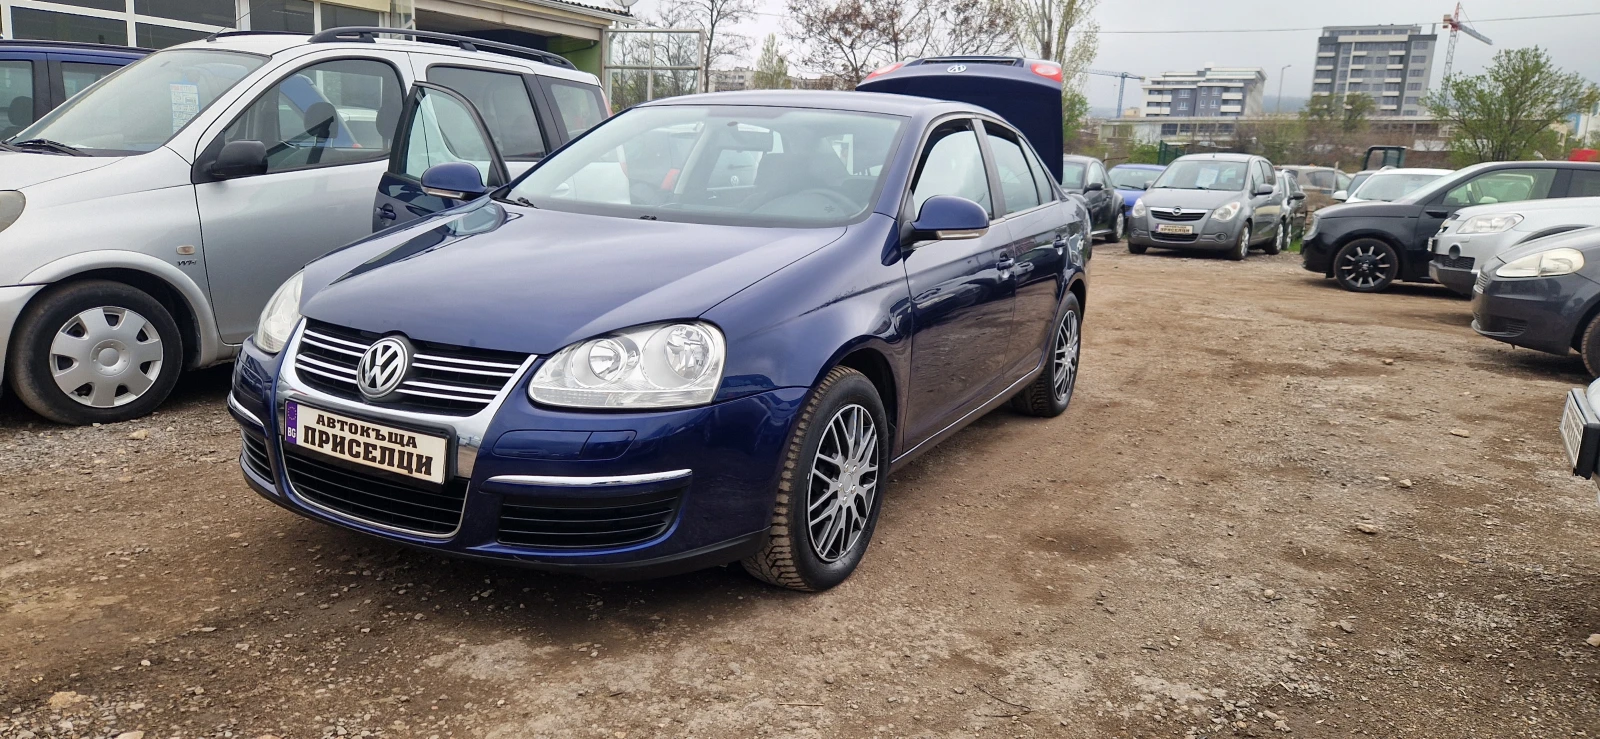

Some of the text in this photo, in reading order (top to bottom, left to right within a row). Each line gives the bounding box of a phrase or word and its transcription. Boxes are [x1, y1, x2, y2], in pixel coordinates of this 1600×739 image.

[359, 339, 406, 395] VW
[287, 427, 296, 438] BG
[303, 425, 433, 476] ПРИСЕЛЦИ
[316, 414, 417, 448] АВТОКЪЩА
